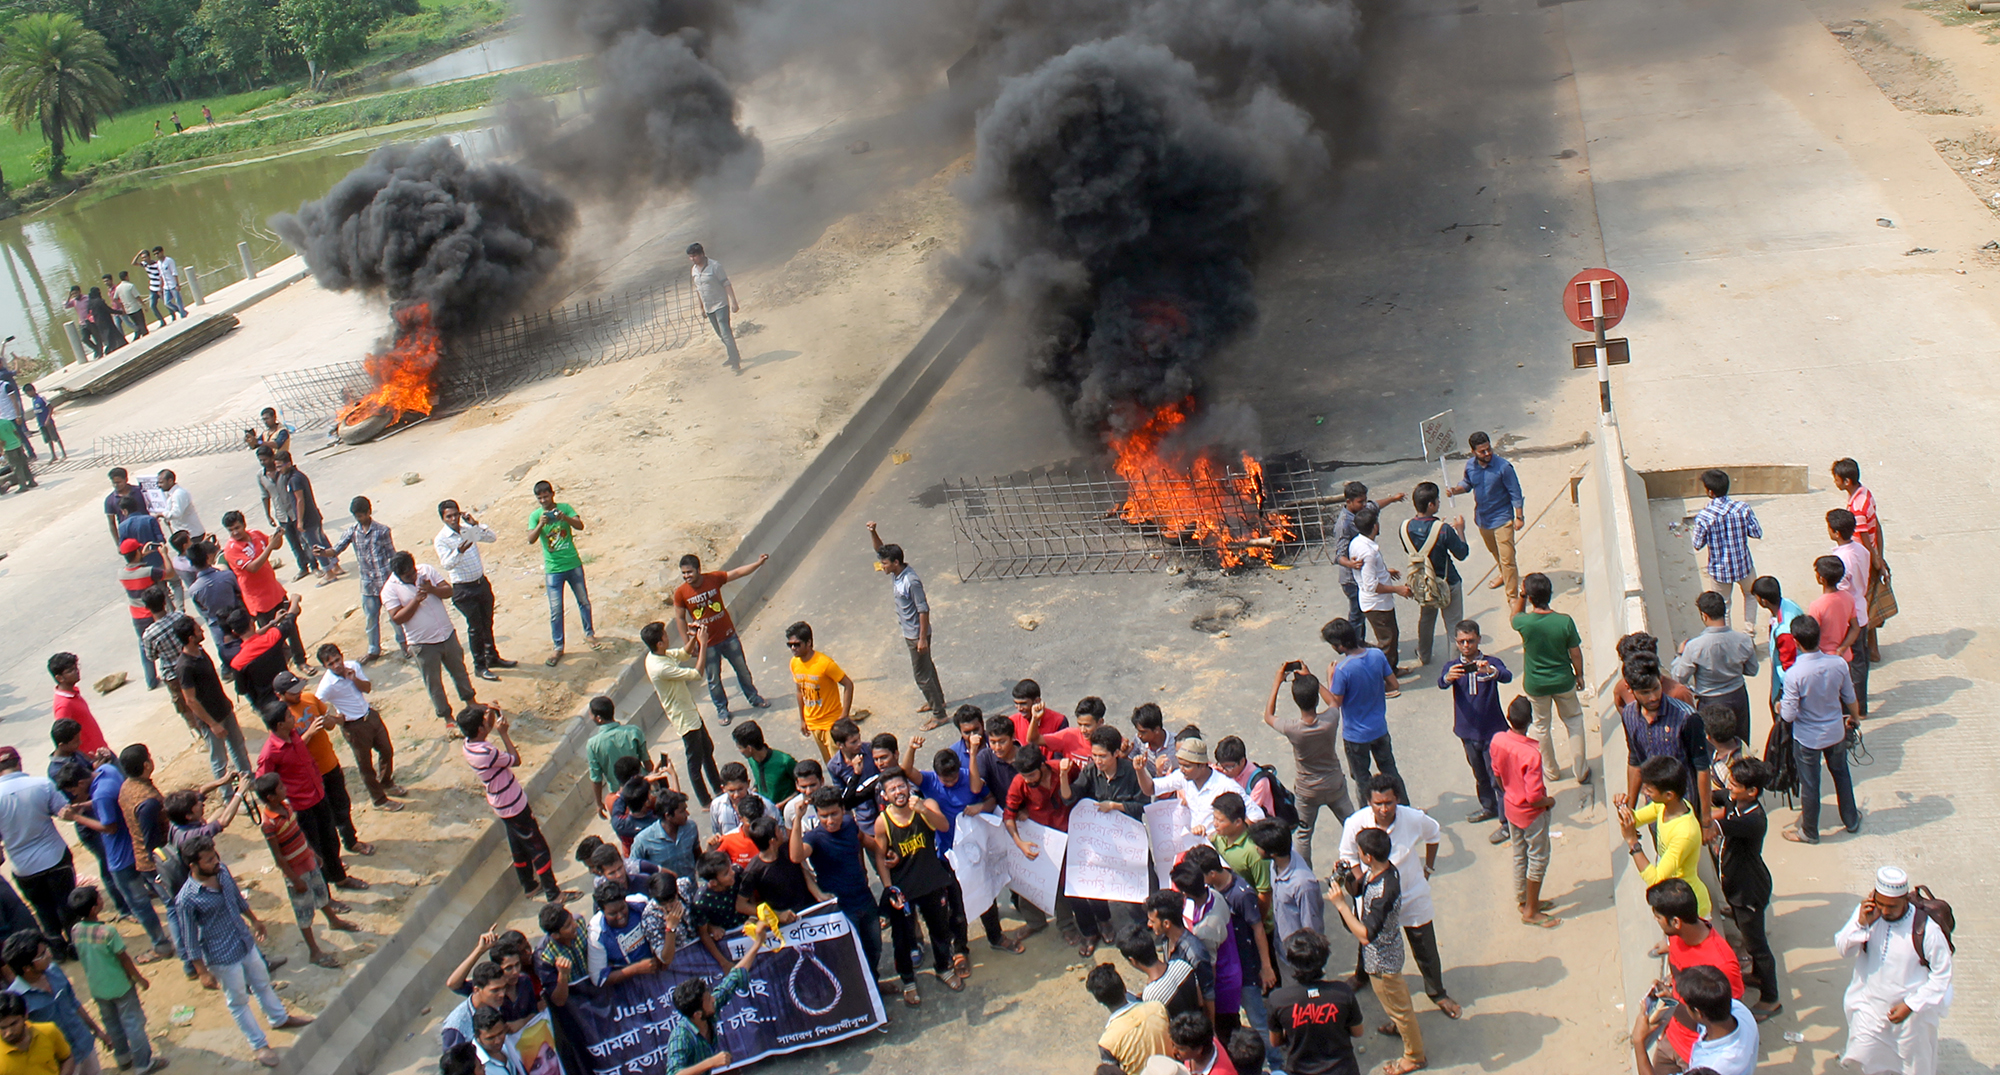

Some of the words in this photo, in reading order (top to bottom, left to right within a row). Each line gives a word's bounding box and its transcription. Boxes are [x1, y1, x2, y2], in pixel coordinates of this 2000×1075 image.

[1426, 423, 1435, 435] NO
[687, 592, 707, 605] TRUST
[708, 588, 717, 598] ME
[789, 920, 842, 941] প্রতিবাদ
[613, 998, 656, 1022] Just
[1291, 1003, 1339, 1029] SLAYER
[586, 1027, 641, 1058] আমরা
